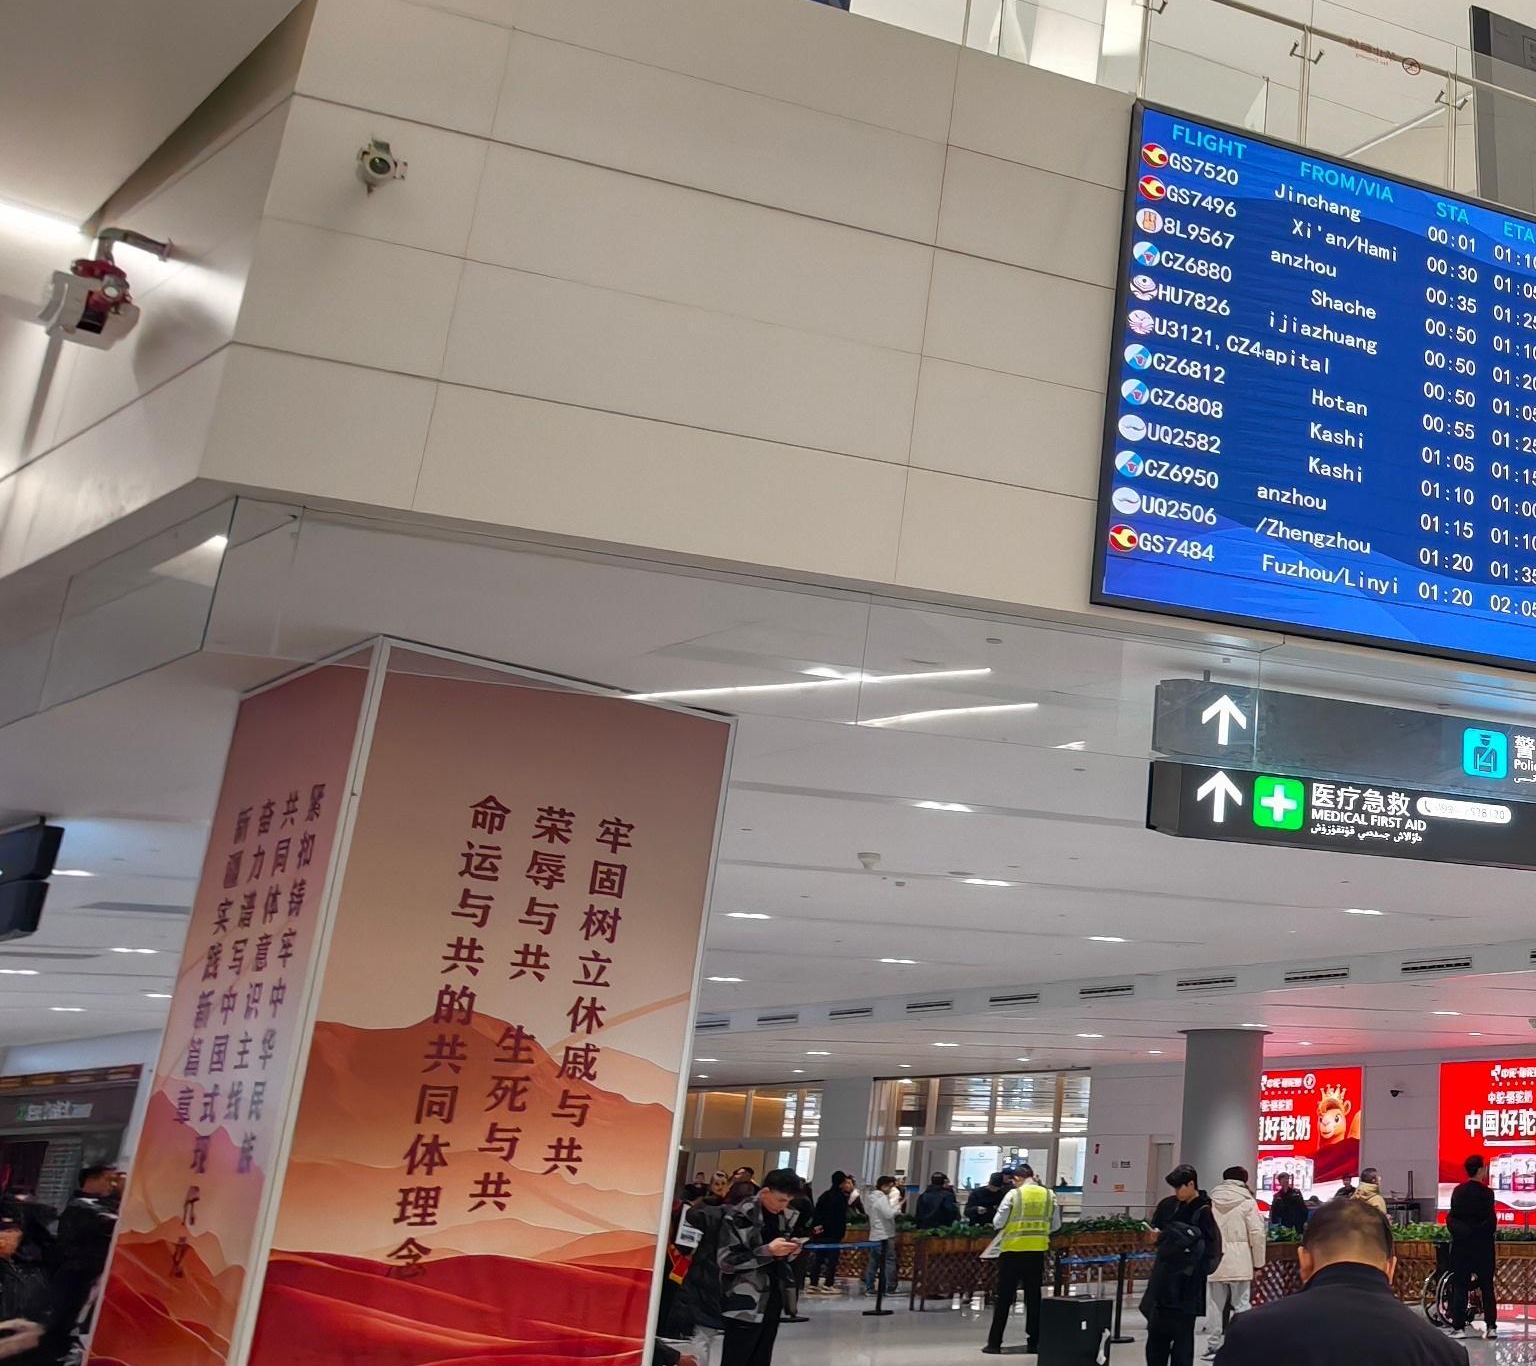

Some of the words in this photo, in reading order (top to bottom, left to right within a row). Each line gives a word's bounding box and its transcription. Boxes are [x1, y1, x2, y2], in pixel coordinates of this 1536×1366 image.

[1165, 152, 1239, 186] GS7520
[1274, 182, 1362, 223] Jinchang
[1427, 225, 1475, 253] 00:01
[1172, 123, 1247, 160] FLIGHT
[1299, 160, 1394, 203] FROM/VIA
[1435, 201, 1470, 225] STA
[1503, 220, 1536, 244] ETA
[1160, 216, 1235, 250] 8L9567
[1425, 286, 1477, 314] 00:35
[1162, 184, 1237, 218] GS7496
[1291, 217, 1397, 262] Xi'an/Hami
[1426, 255, 1478, 284] 00:30
[1157, 282, 1231, 316] HU7826
[1423, 348, 1476, 377] 00:50
[1160, 249, 1232, 283] CZ6880
[1310, 288, 1377, 320] Shache
[1424, 317, 1477, 345] 00:50
[1149, 387, 1223, 419] CZ6808
[1309, 421, 1363, 449] Kashi
[1421, 445, 1475, 473] 01:05
[1152, 352, 1226, 385] CZ6812
[1311, 387, 1368, 417] Hotan
[1421, 413, 1475, 440] 00:55
[1422, 380, 1476, 408] 00:50
[1143, 458, 1219, 490] CZ6950
[1419, 512, 1474, 539] 01:15
[1146, 421, 1221, 454] UQ2582
[1307, 455, 1362, 483] Kashi
[1420, 479, 1475, 506] 01:10
[1136, 531, 1215, 562] GS7484
[1261, 553, 1398, 595] Fuzhou/Linyi
[1418, 581, 1473, 607] 01:20
[1140, 494, 1217, 526] UQ2506
[1418, 547, 1473, 573] 01:20
[1311, 782, 1411, 817] 医疗急救
[1311, 809, 1368, 826] MEDICAL
[1371, 814, 1402, 830] FIRST
[1405, 819, 1427, 832] AID
[507, 805, 576, 985] 荣辱与共
[223, 791, 299, 1123] 共同体意识主线
[542, 816, 636, 1177] 牢固树立休戚与共
[386, 794, 512, 1279] 命运与共的共同体理念
[467, 1024, 537, 1213] 生死与共
